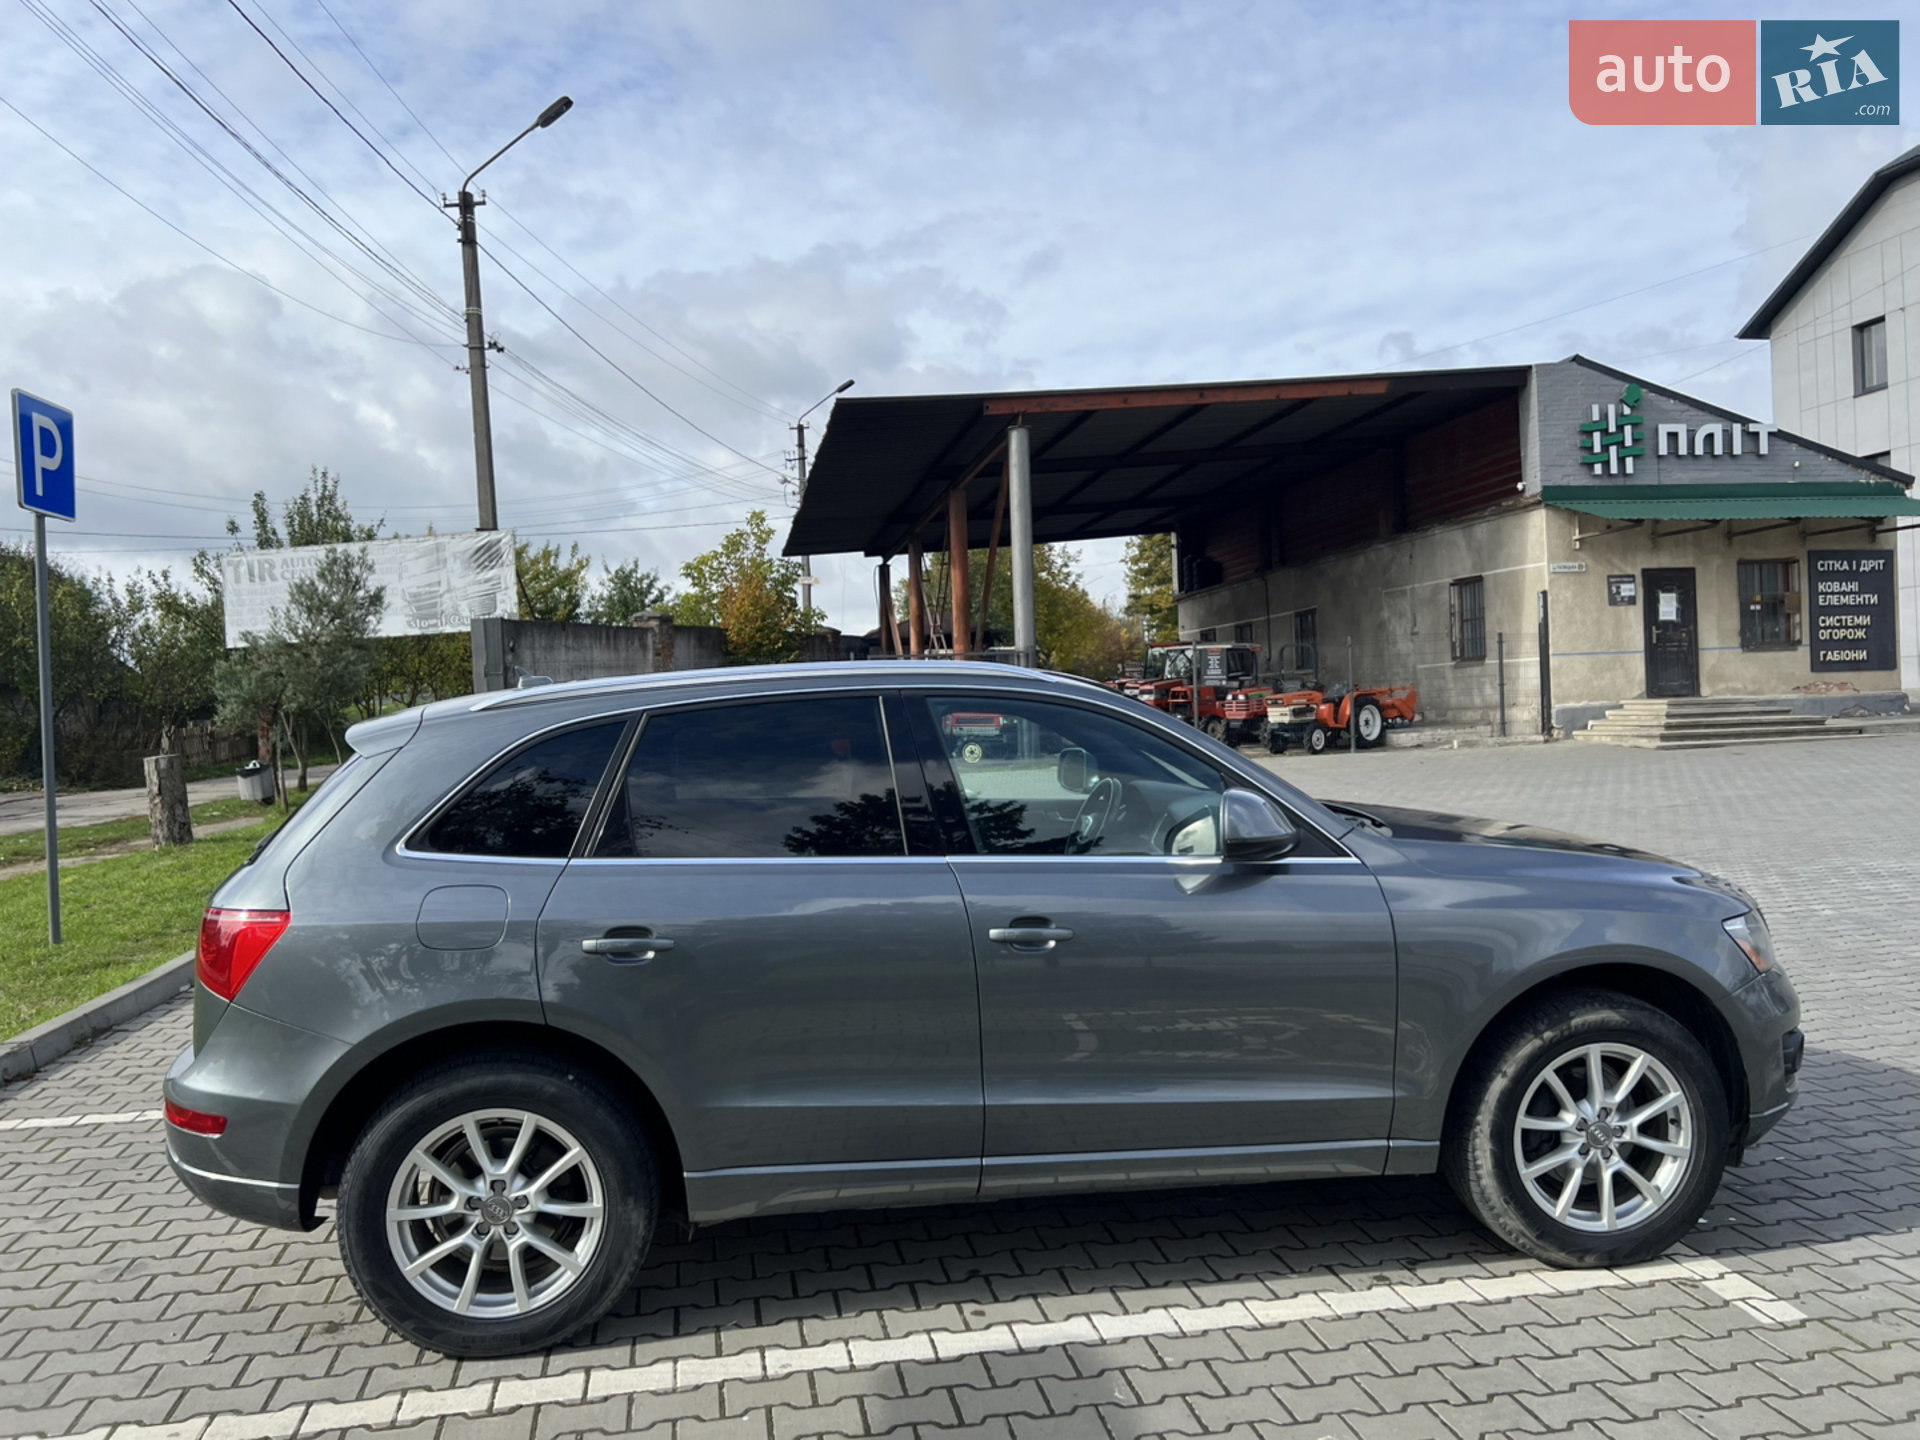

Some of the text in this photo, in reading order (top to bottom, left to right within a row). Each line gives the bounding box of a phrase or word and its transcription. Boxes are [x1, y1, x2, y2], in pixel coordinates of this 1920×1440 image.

[1657, 423, 1779, 456] ПЛІТ
[32, 411, 63, 497] P
[227, 558, 279, 584] TIR
[1817, 560, 1885, 572] СІТКА І ДРІТ
[1818, 581, 1859, 593] КОВАНІ
[1818, 594, 1878, 606] ЕЛЕМЕНТИ
[1818, 615, 1871, 627] СИСТЕМИ
[1819, 628, 1866, 640] ОГОРОЖ
[1820, 650, 1867, 661] ГАБІОНИ
